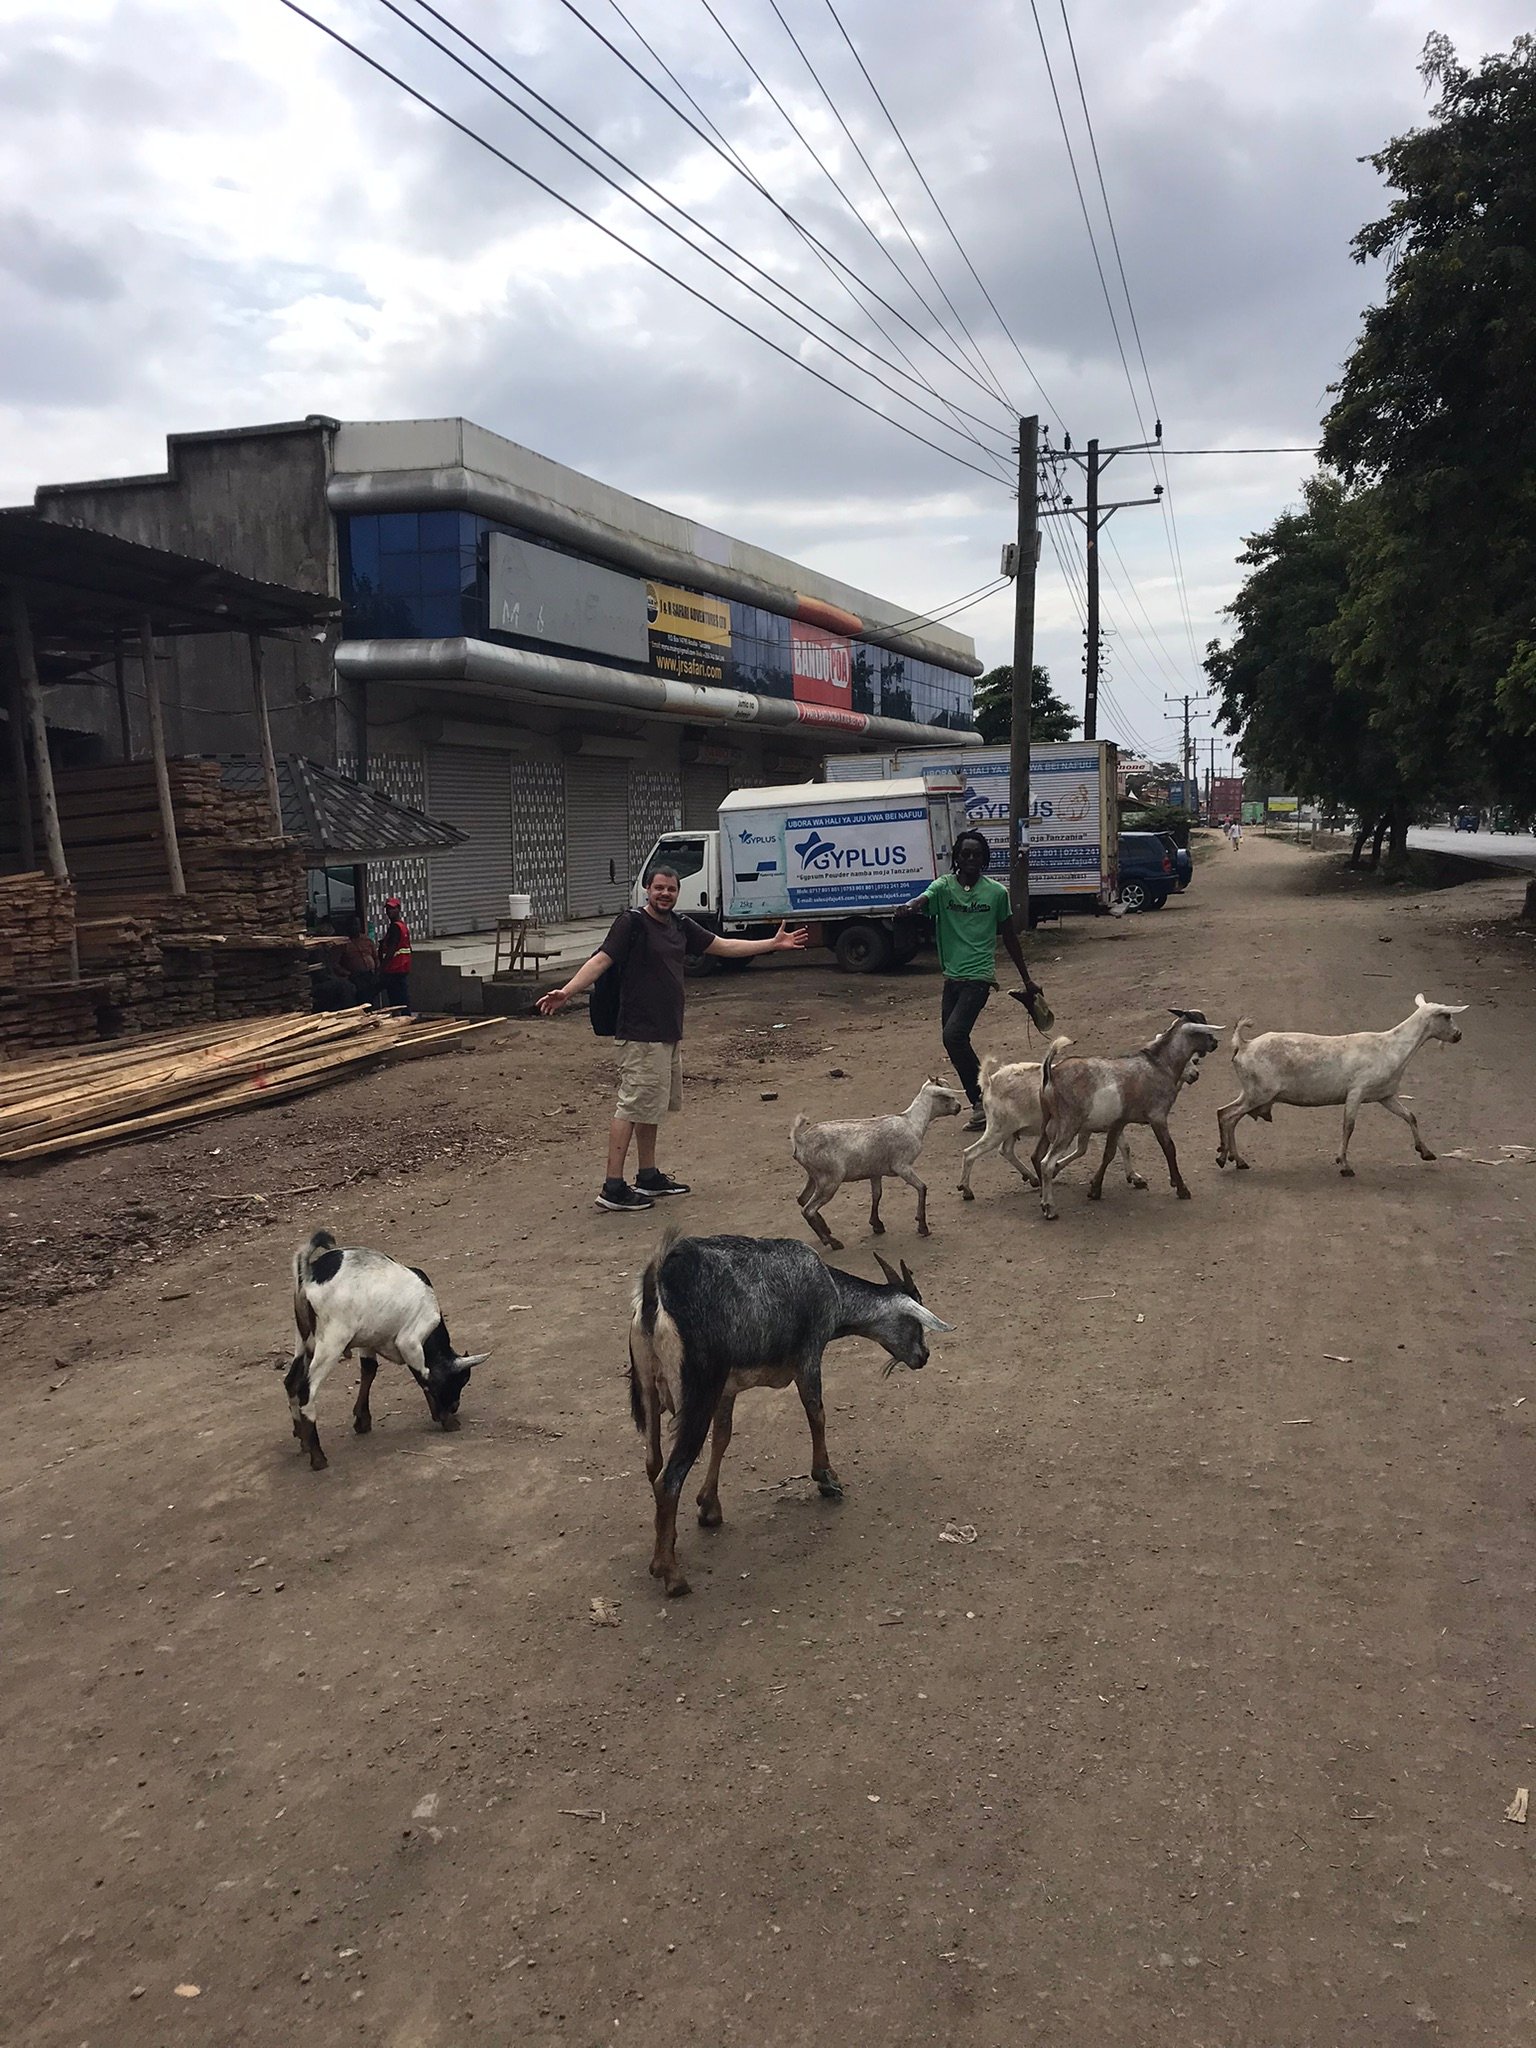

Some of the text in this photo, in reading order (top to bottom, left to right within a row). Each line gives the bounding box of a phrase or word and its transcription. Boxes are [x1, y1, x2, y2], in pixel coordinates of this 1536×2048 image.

[673, 602, 690, 620] SAFARI
[691, 606, 719, 627] ADVENTURES
[656, 655, 722, 679] www.jrsafari.com
[794, 638, 830, 682] BANDO
[788, 820, 812, 828] UBORA
[853, 815, 867, 823] JUU
[868, 814, 885, 822] KWA
[885, 813, 897, 821] BEI
[898, 811, 923, 819] NAFUU
[968, 801, 1053, 819] GYPUS
[813, 846, 907, 870] GYPLUS
[825, 870, 849, 879] Powder
[850, 869, 872, 877] namba
[873, 868, 890, 876] moja
